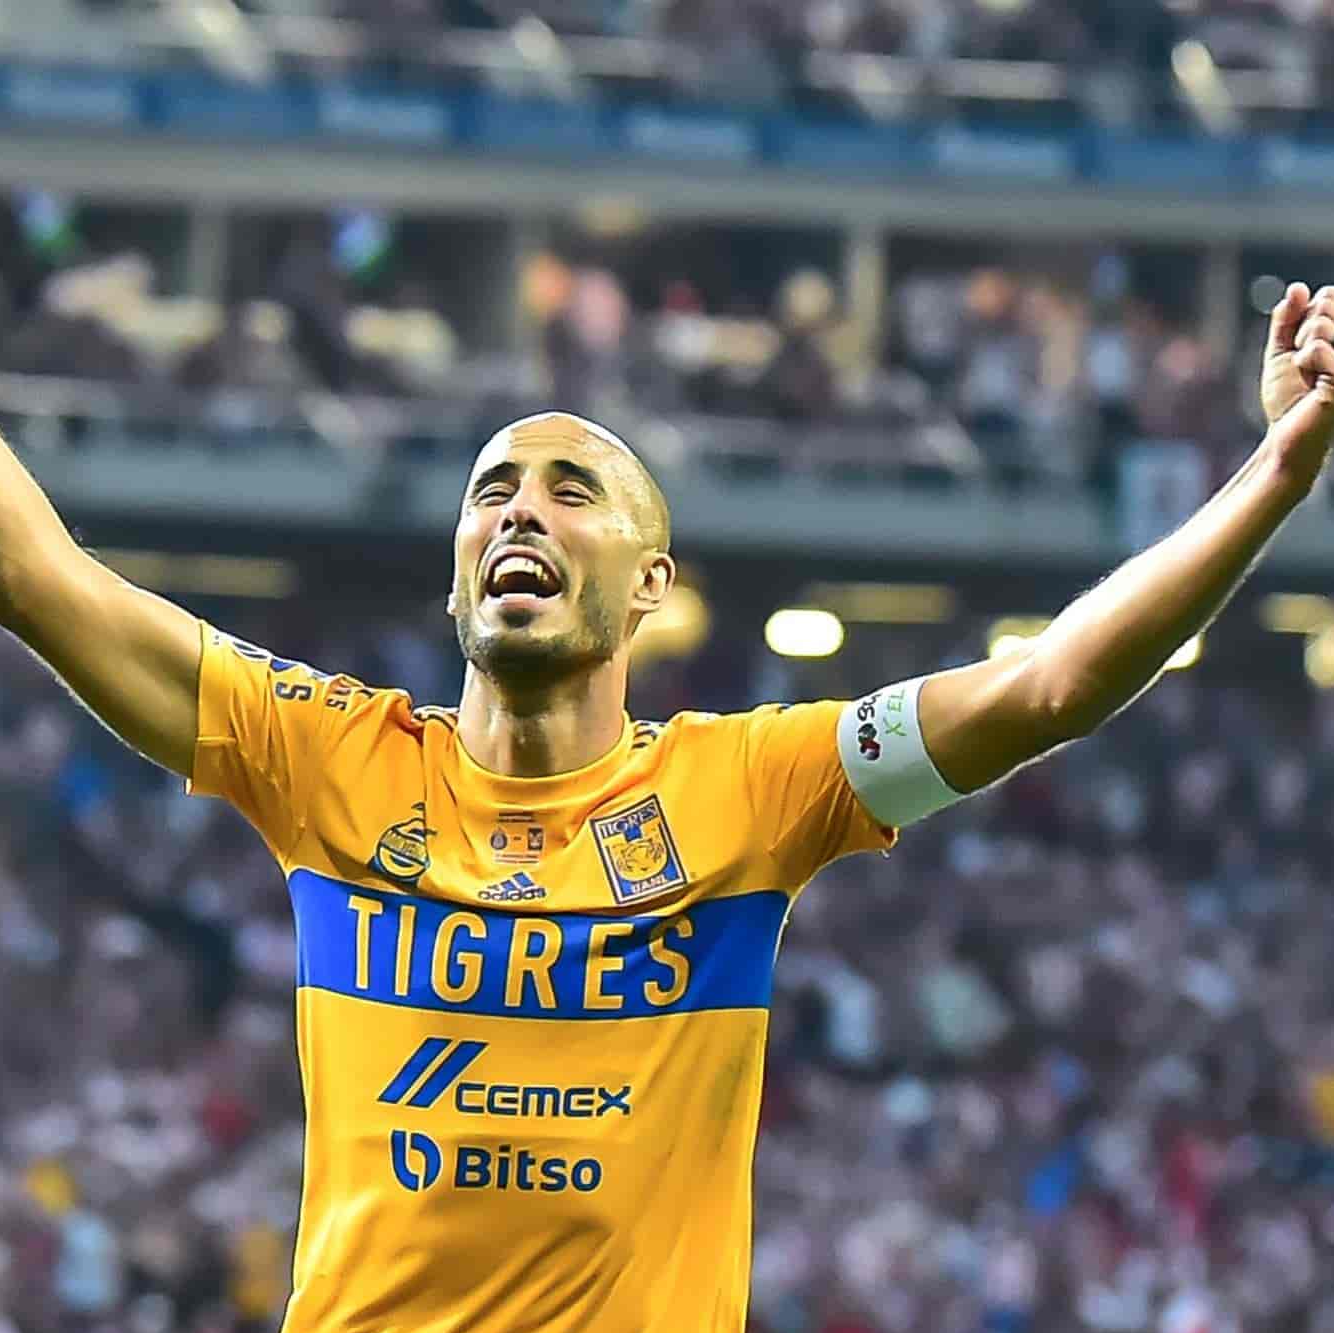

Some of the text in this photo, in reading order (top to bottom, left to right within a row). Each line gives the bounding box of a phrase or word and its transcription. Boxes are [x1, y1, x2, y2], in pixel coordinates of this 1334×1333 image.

[348, 894, 694, 1010] TIGRES
[454, 1081, 632, 1118] CEMEX
[453, 1144, 603, 1192] Bitso
